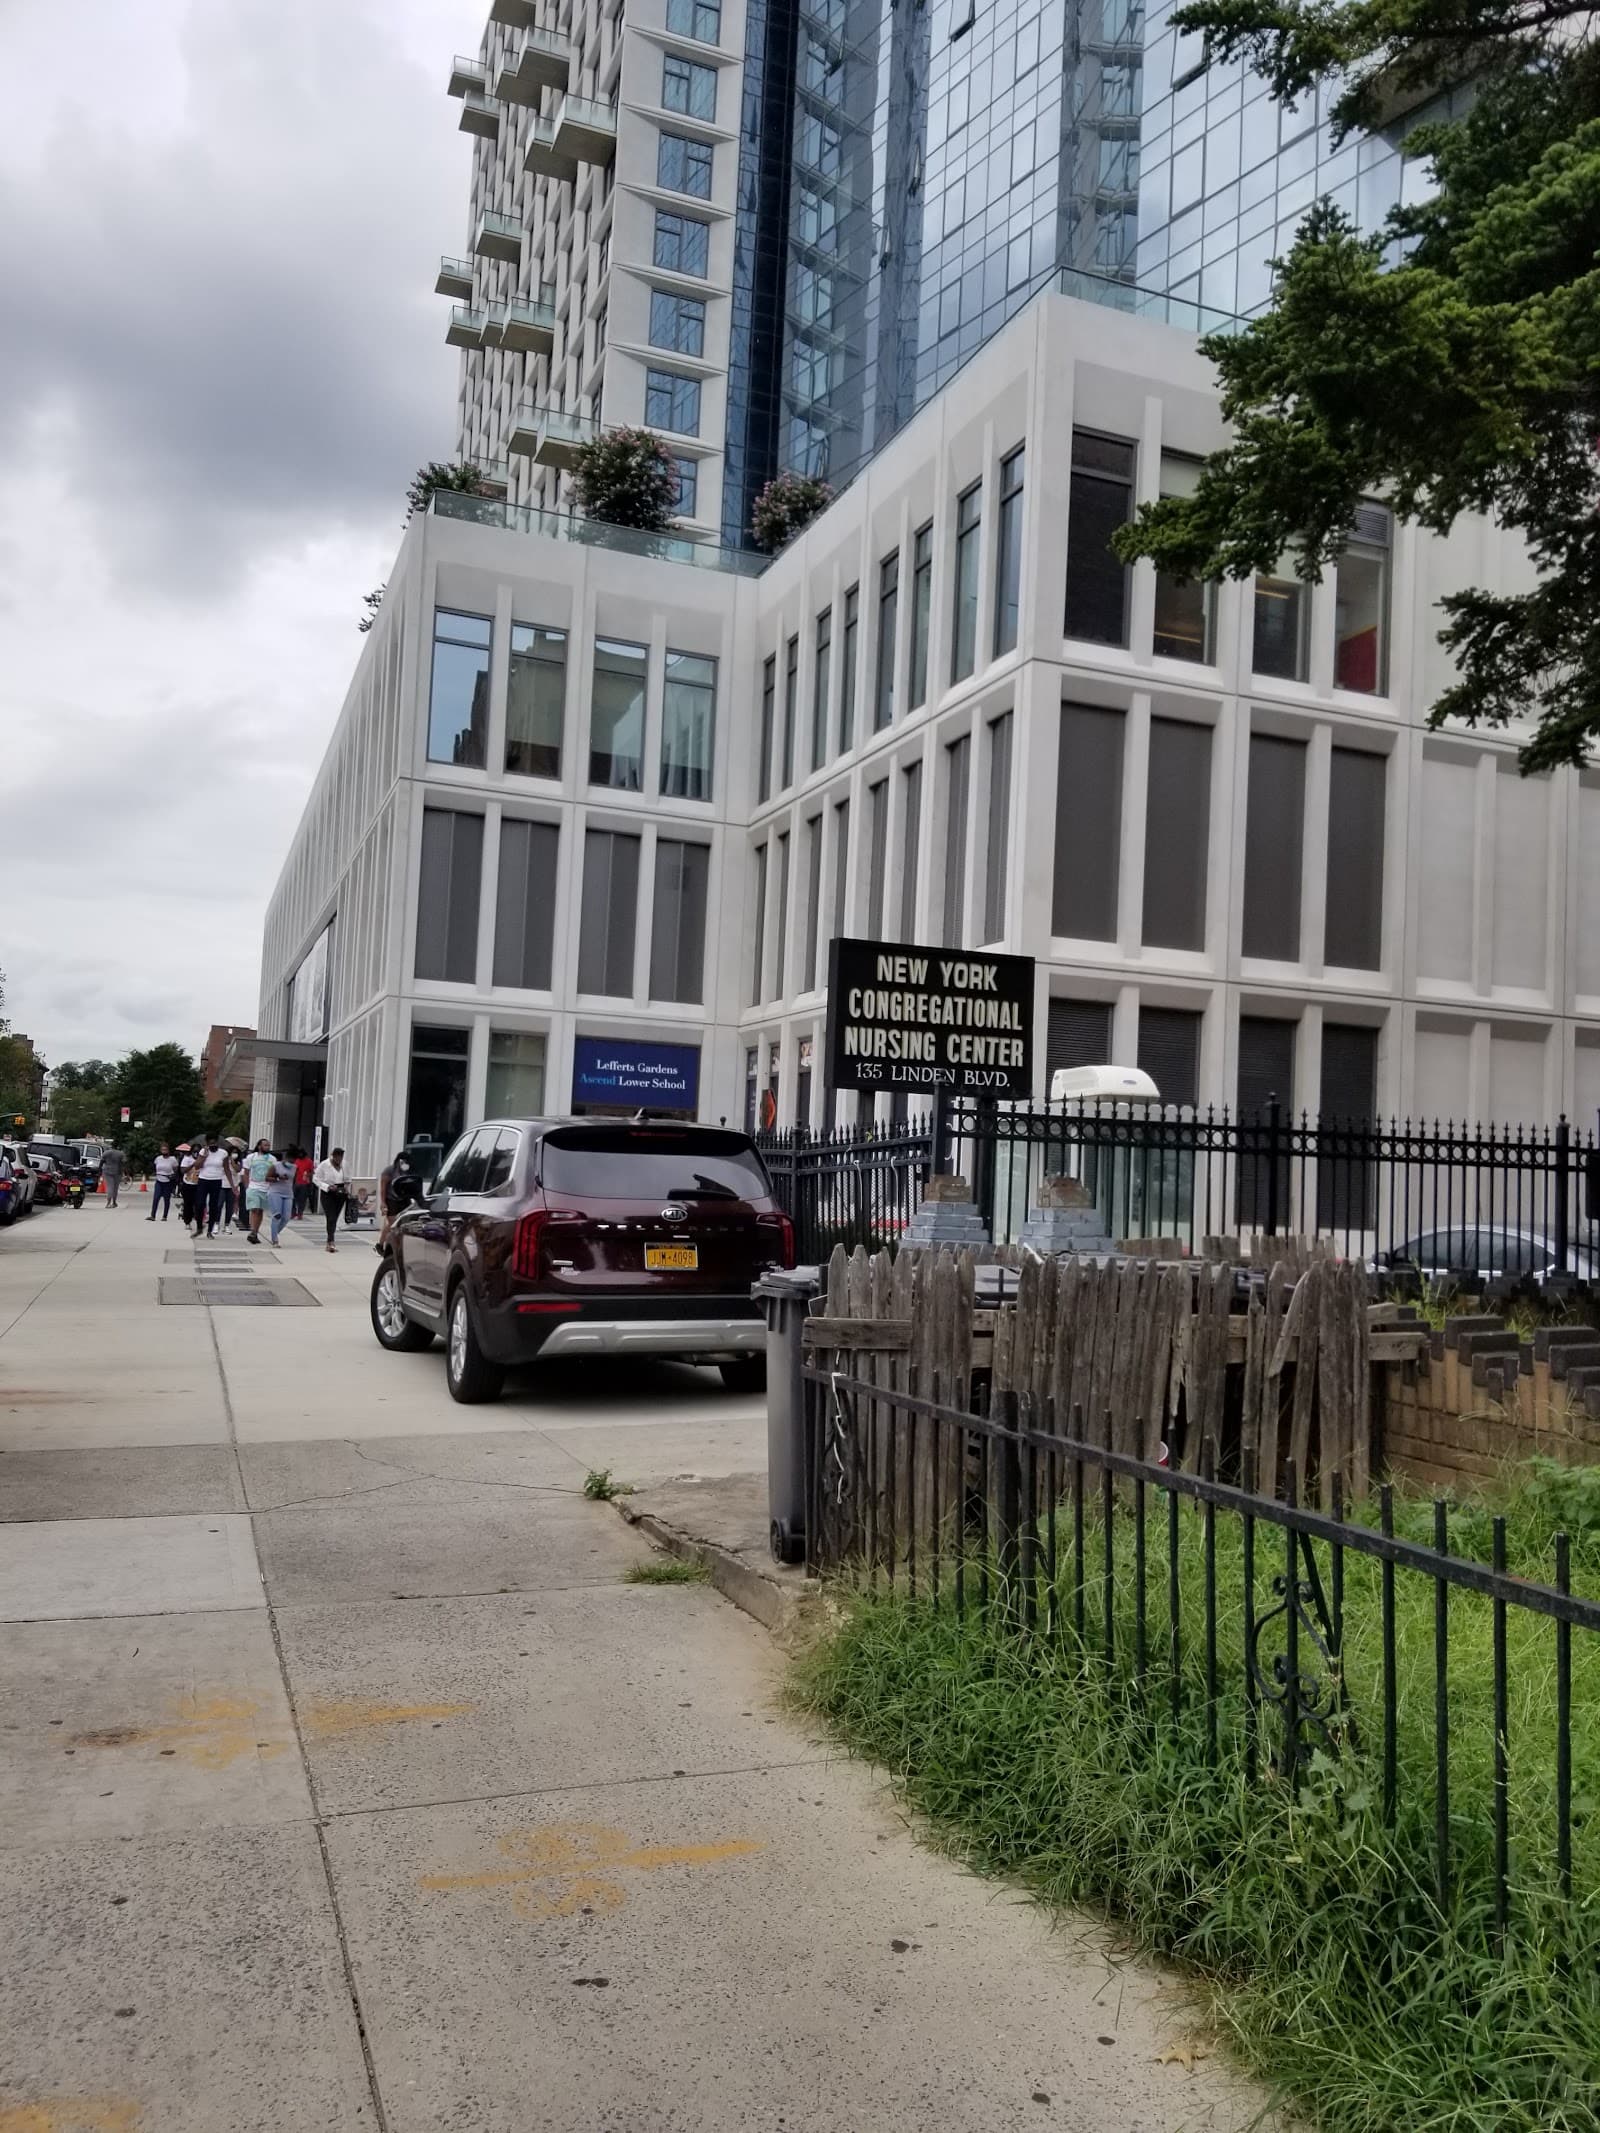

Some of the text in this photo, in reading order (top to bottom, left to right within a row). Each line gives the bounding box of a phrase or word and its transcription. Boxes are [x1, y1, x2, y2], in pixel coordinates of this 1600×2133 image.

[876, 954, 999, 992] NEW YORK
[848, 988, 1024, 1031] CONGREGATIONAL
[844, 1025, 1024, 1067] NURSING CENTER
[581, 1073, 686, 1090] Ascend Lower School
[596, 1059, 678, 1075] Lefferts Gardens
[855, 1062, 1011, 1087] 135 LINDEN BLVD.
